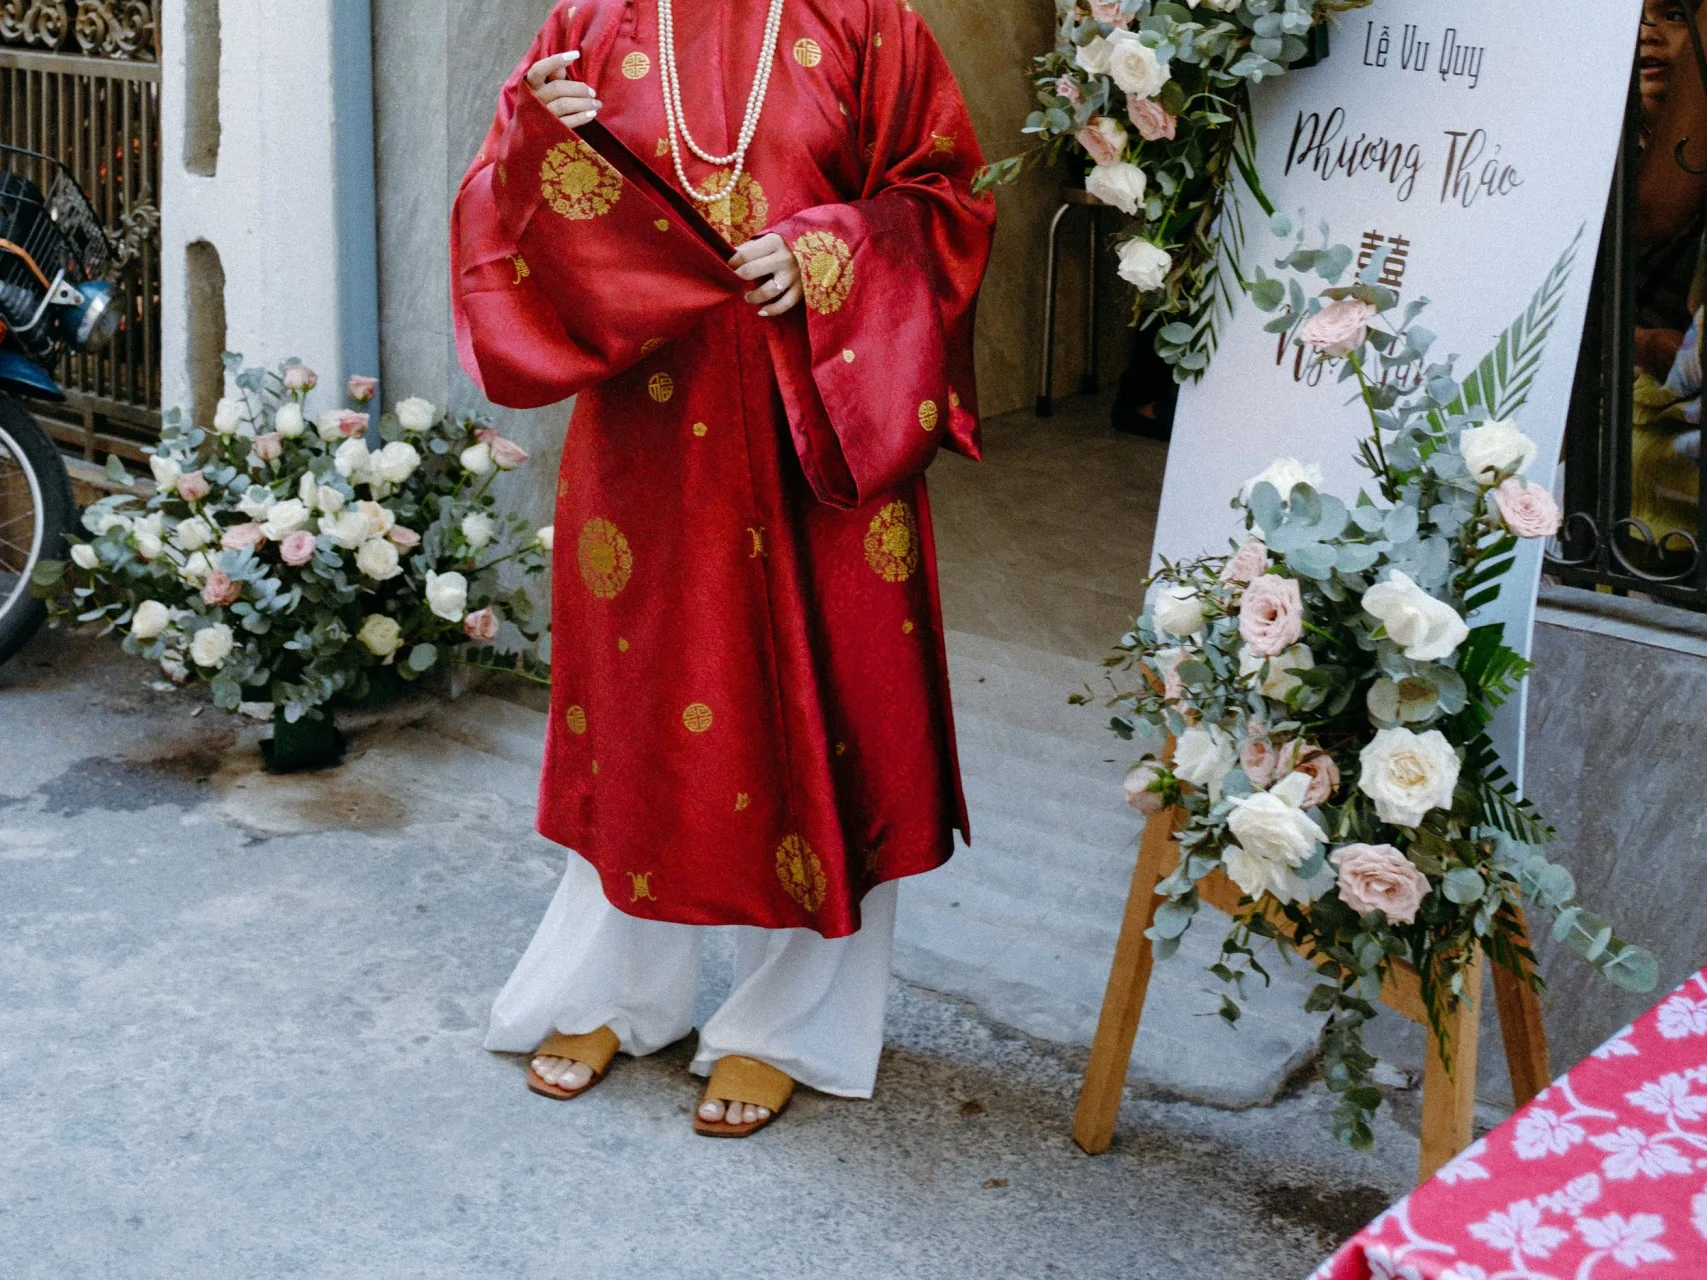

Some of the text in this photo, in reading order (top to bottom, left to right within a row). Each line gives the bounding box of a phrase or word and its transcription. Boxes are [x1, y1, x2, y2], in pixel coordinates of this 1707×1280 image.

[1363, 20, 1483, 89] Lễ Vu Quy
[1284, 107, 1524, 208] Phương Thảo
